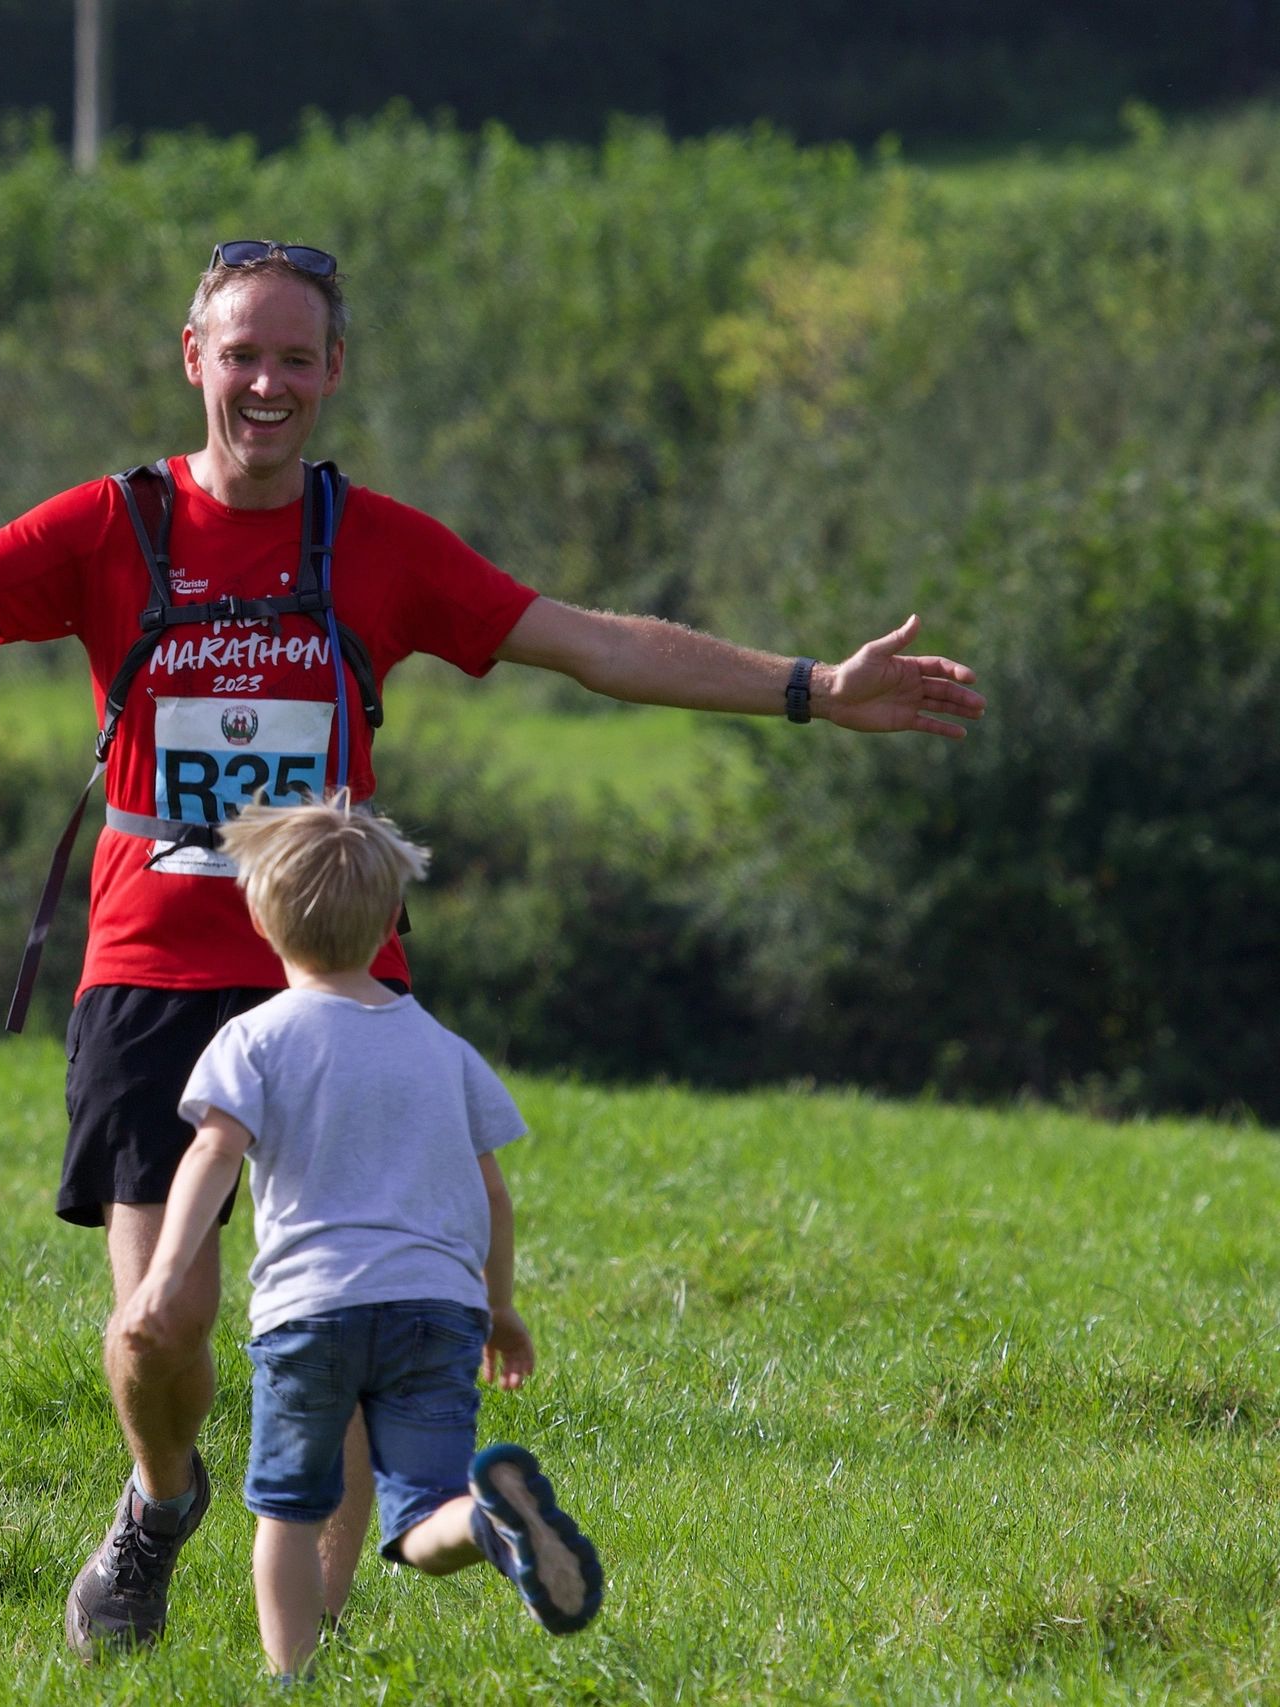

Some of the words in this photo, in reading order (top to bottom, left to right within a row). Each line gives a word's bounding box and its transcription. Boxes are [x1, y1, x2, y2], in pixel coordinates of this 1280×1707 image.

[169, 568, 185, 577] Bell
[183, 579, 209, 588] bristol
[150, 632, 330, 675] MARATHON
[212, 674, 264, 693] 2023
[165, 751, 316, 823] R35
